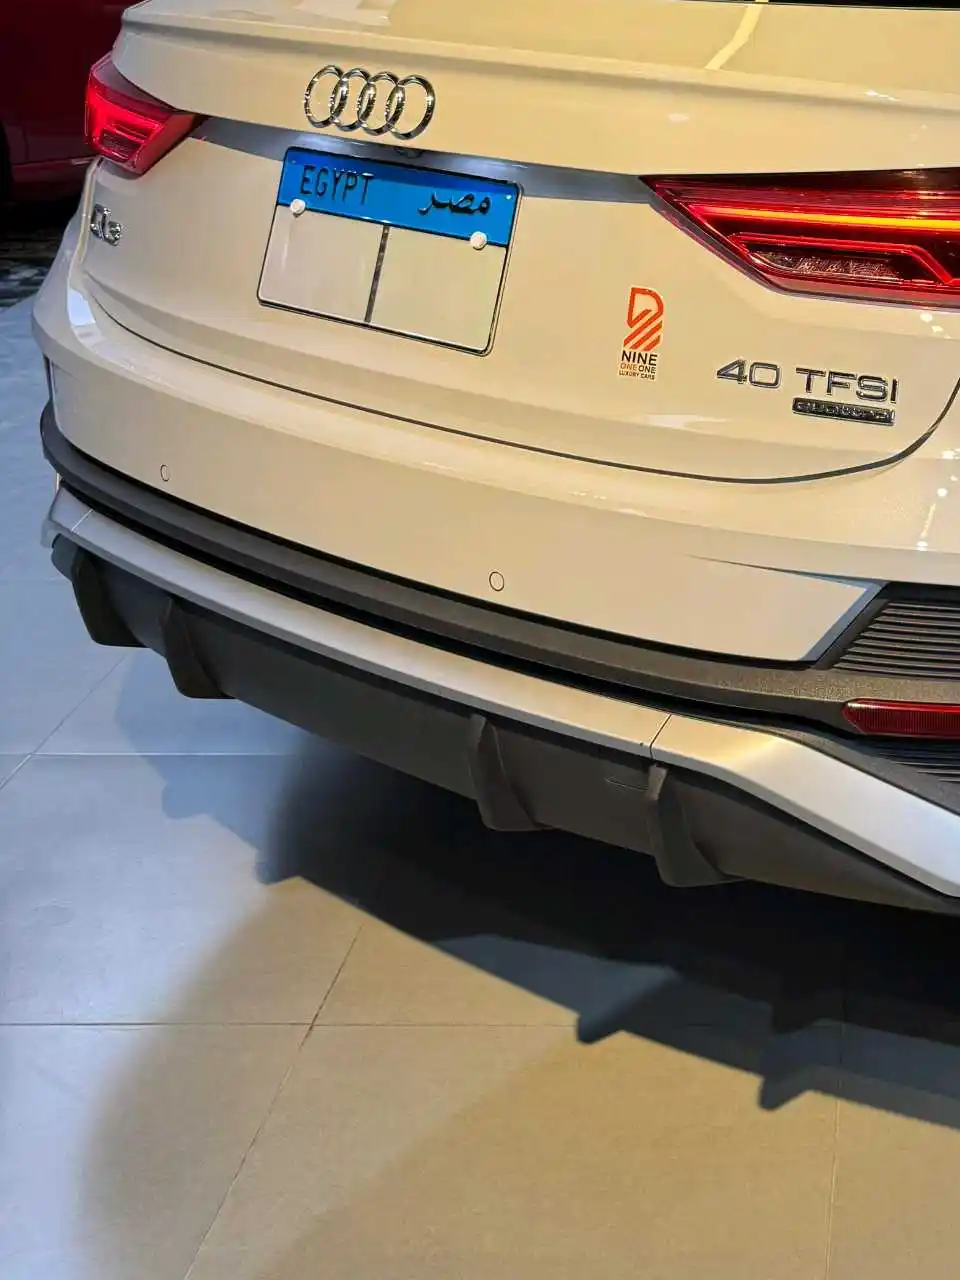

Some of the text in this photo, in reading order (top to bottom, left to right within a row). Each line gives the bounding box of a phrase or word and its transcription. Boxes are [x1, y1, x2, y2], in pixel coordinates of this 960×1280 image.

[300, 165, 374, 205] EGYPT
[417, 191, 491, 216] مصر
[620, 362, 657, 374] ONE ONE
[621, 350, 658, 366] NINE
[716, 359, 898, 404] 40 TFSI
